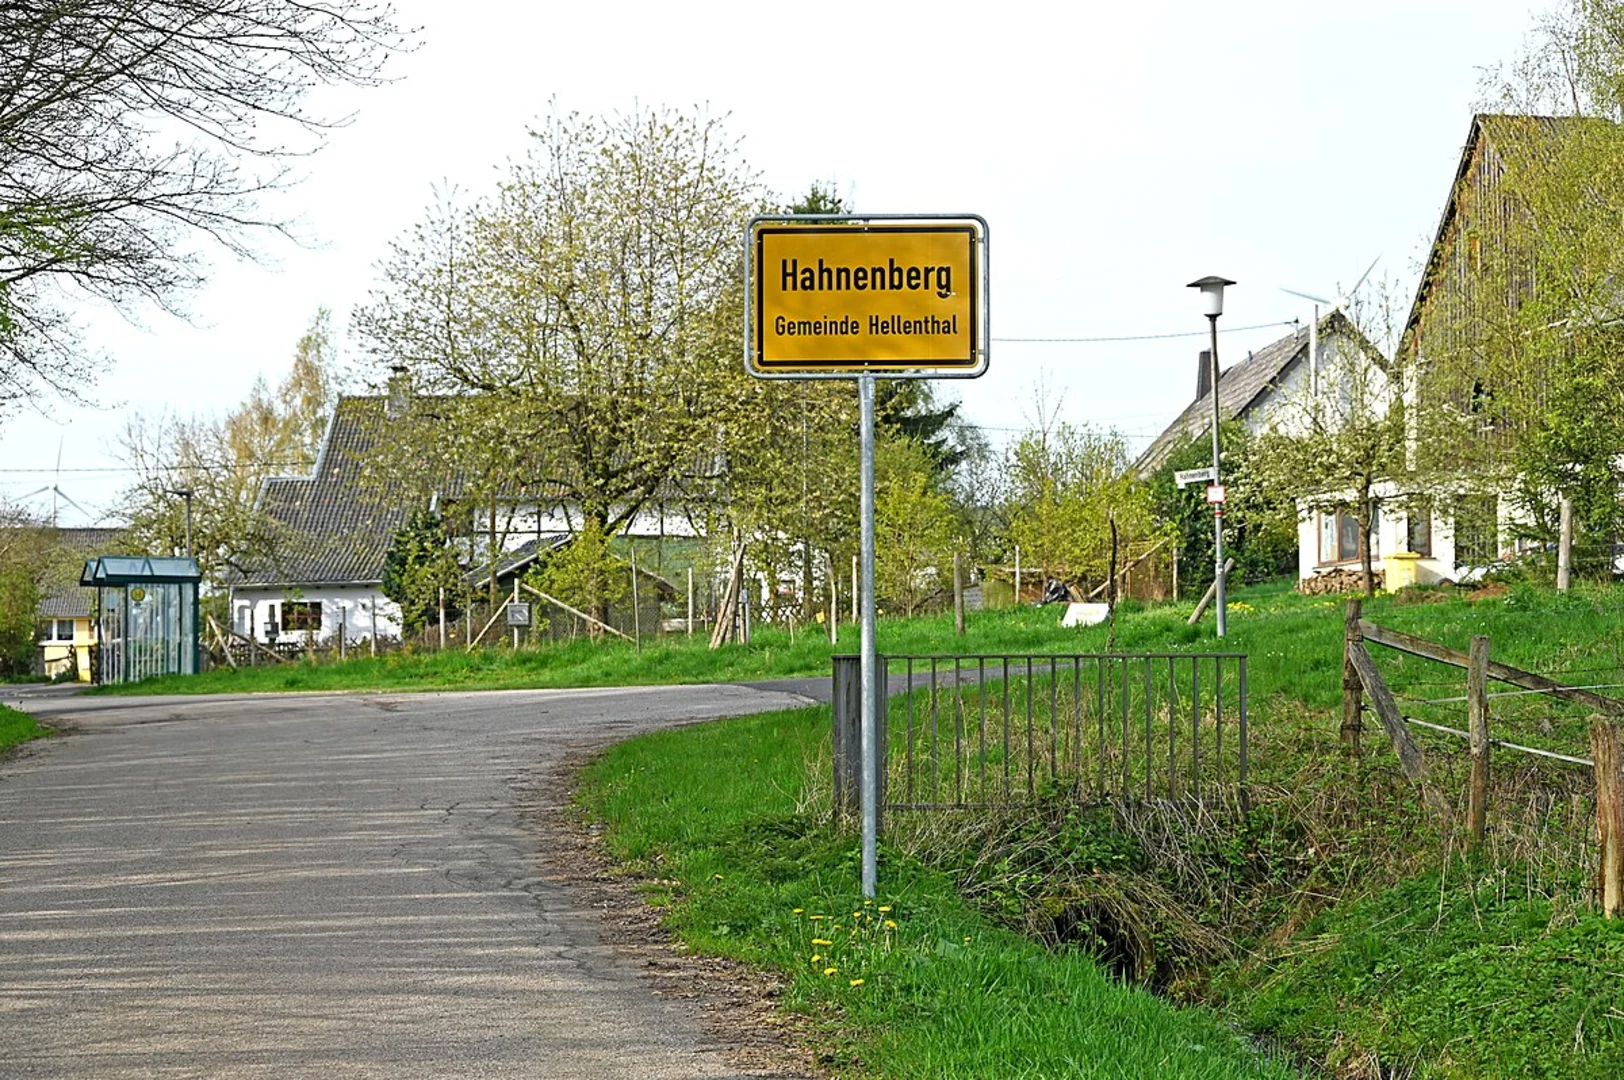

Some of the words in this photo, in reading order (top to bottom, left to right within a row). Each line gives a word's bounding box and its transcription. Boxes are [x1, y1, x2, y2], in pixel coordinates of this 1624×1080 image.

[781, 258, 952, 299] Hahnenberg
[775, 315, 860, 336] Gemeinde
[868, 314, 958, 335] Hellenthal
